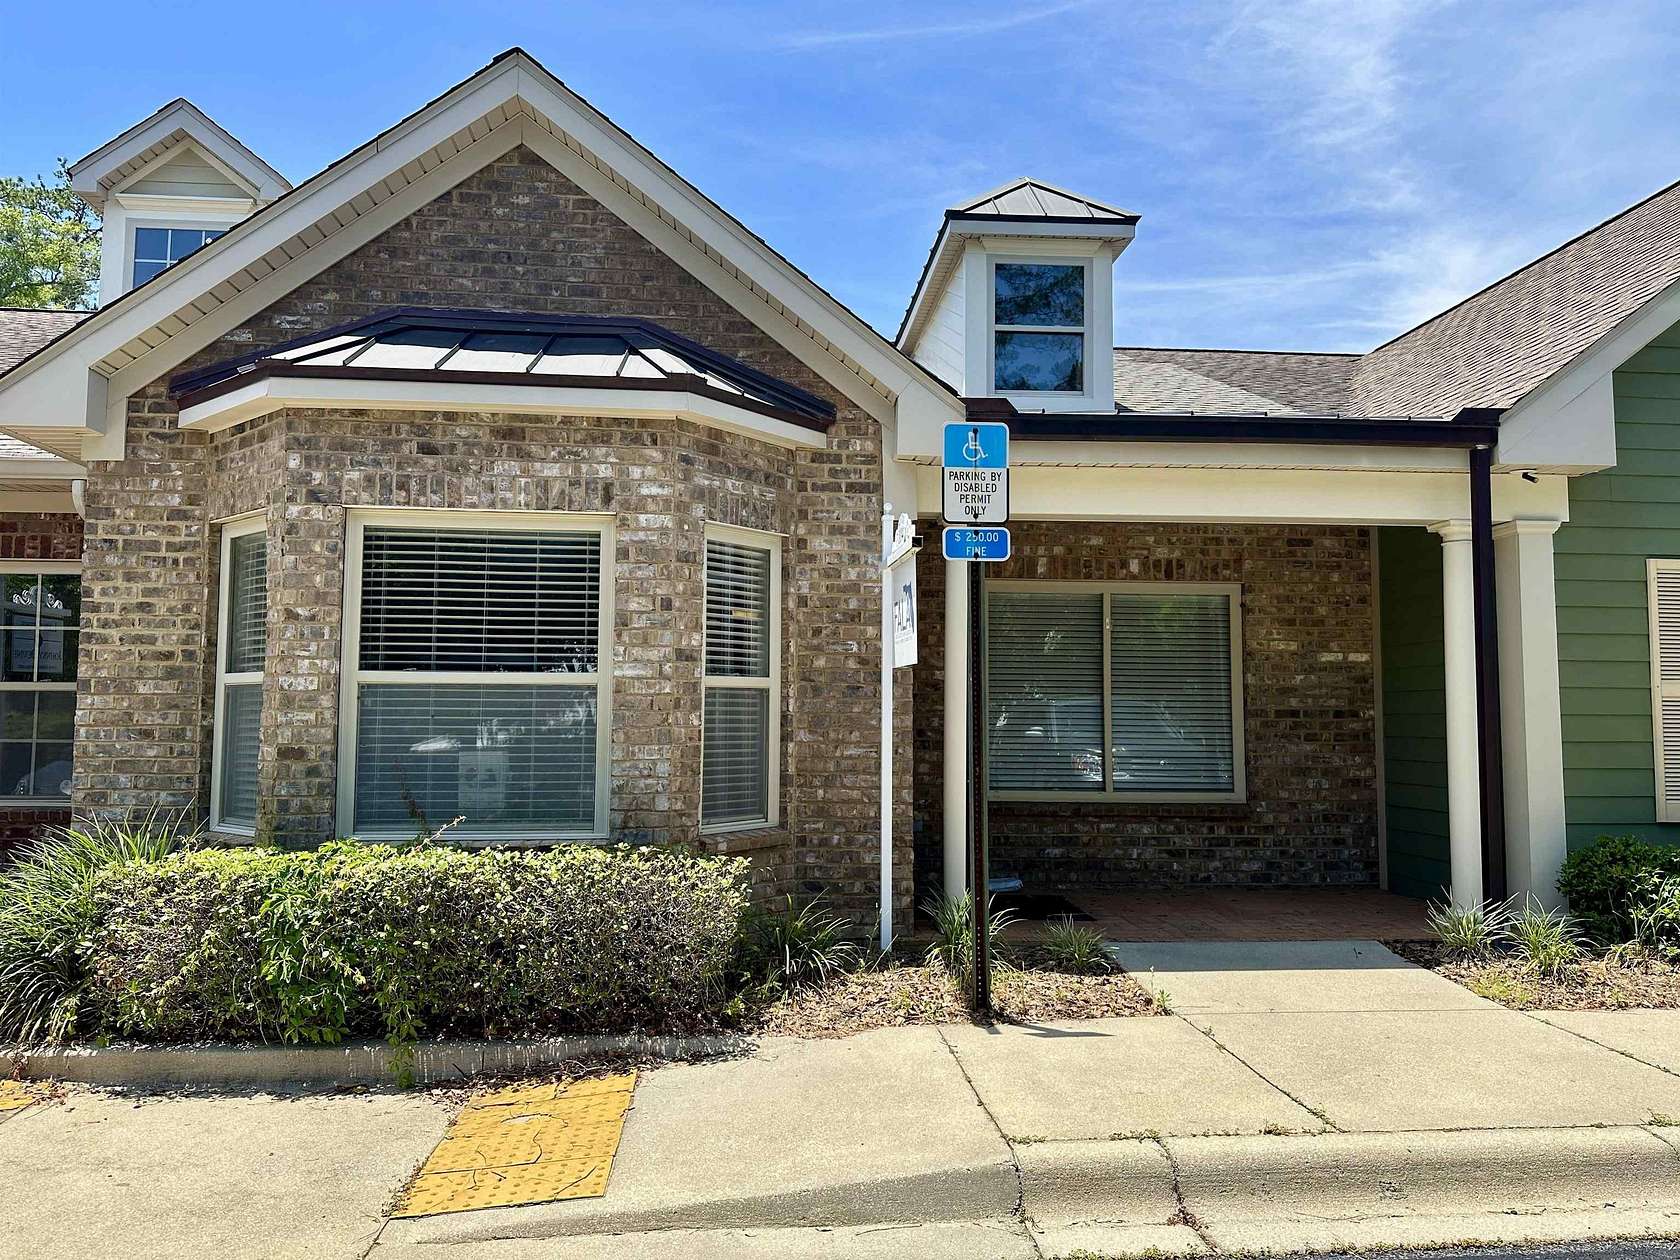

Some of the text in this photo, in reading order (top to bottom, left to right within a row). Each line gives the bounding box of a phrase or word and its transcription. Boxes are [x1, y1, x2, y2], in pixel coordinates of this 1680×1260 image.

[948, 471, 1002, 481] PARKING BY
[954, 482, 997, 493] DISABLED
[959, 494, 991, 504] PERMIT
[964, 505, 986, 516] ONLY
[966, 546, 987, 557] FINE
